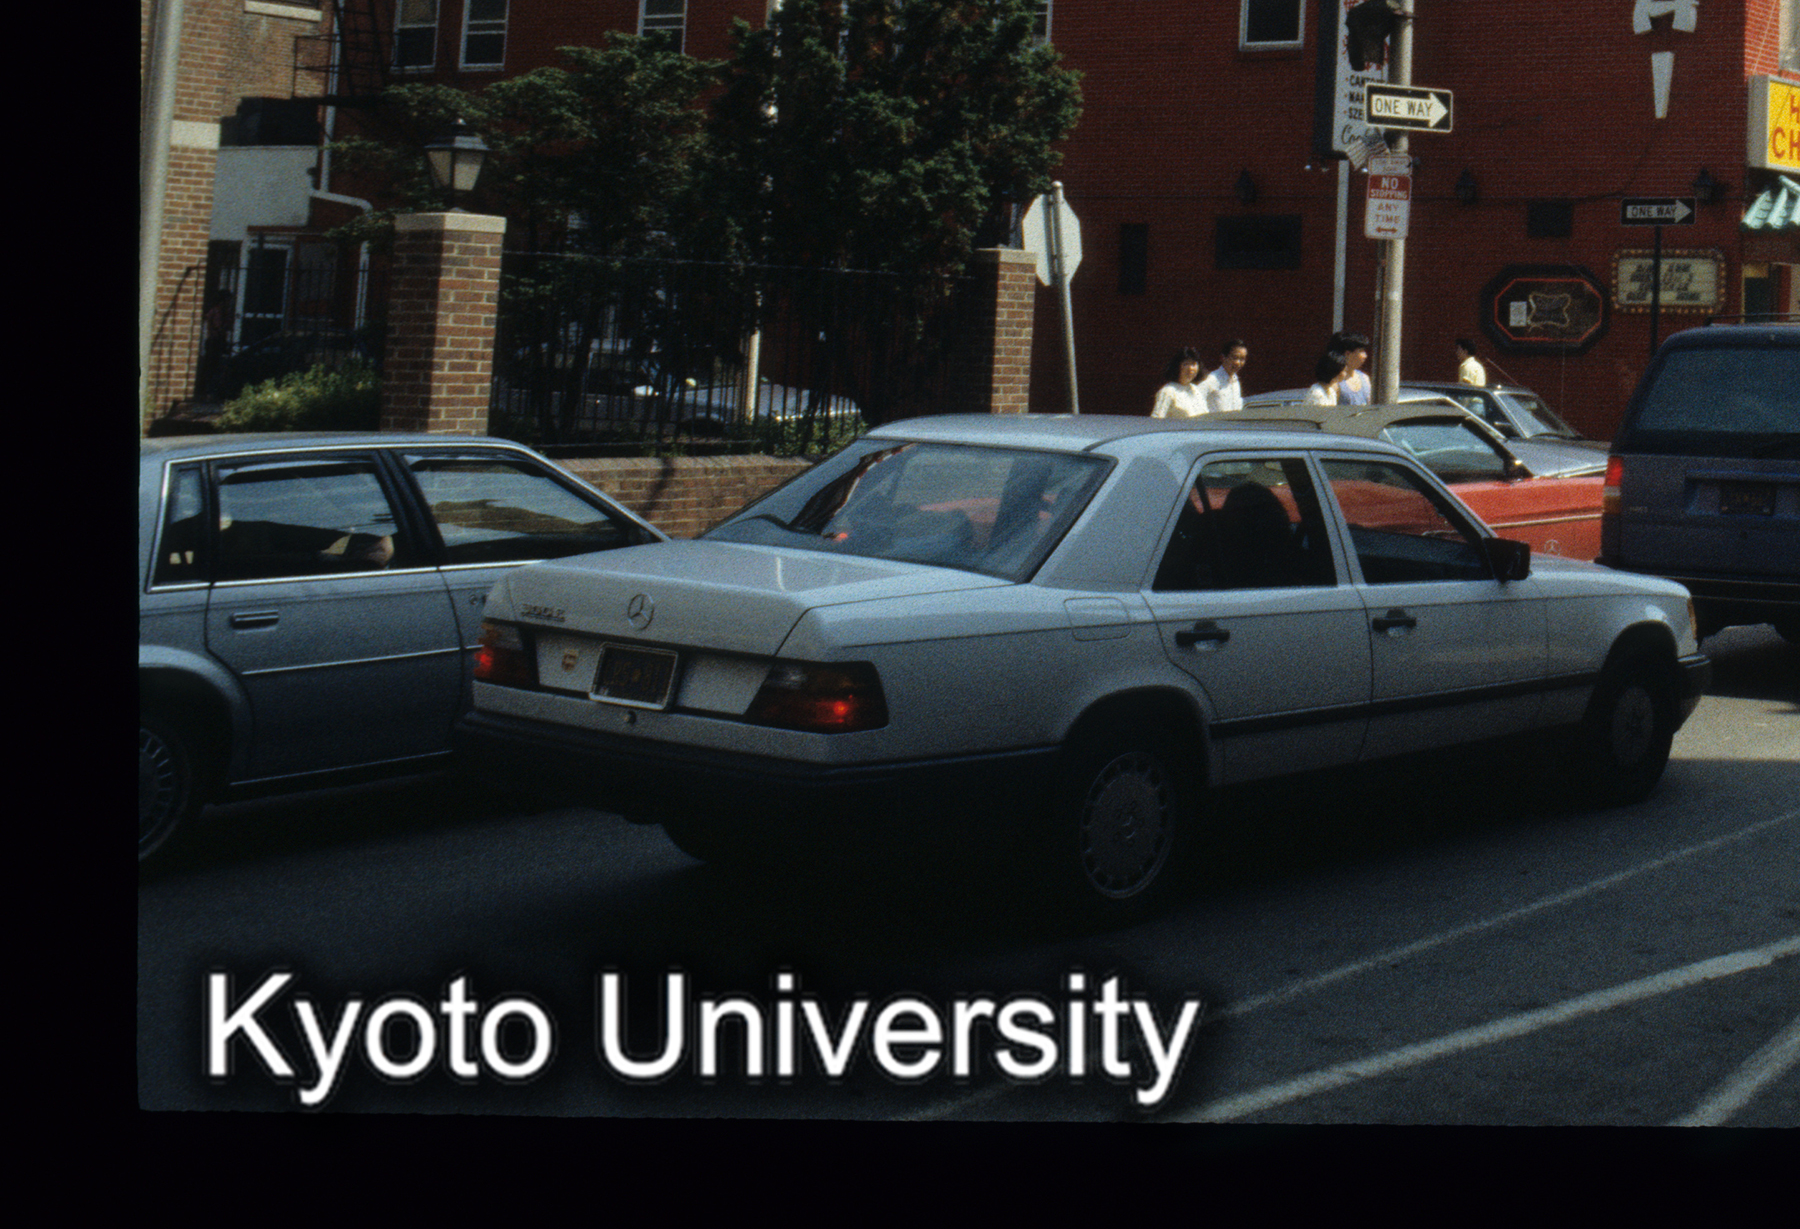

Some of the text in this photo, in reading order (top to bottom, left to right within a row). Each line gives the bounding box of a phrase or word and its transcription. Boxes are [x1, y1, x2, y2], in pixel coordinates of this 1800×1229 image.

[1375, 97, 1400, 114] ONE
[1406, 100, 1433, 118] WAY
[1381, 177, 1399, 190] NO
[1377, 202, 1399, 212] ANY
[1631, 206, 1678, 217] ONE WAY
[1375, 214, 1400, 224] TIME
